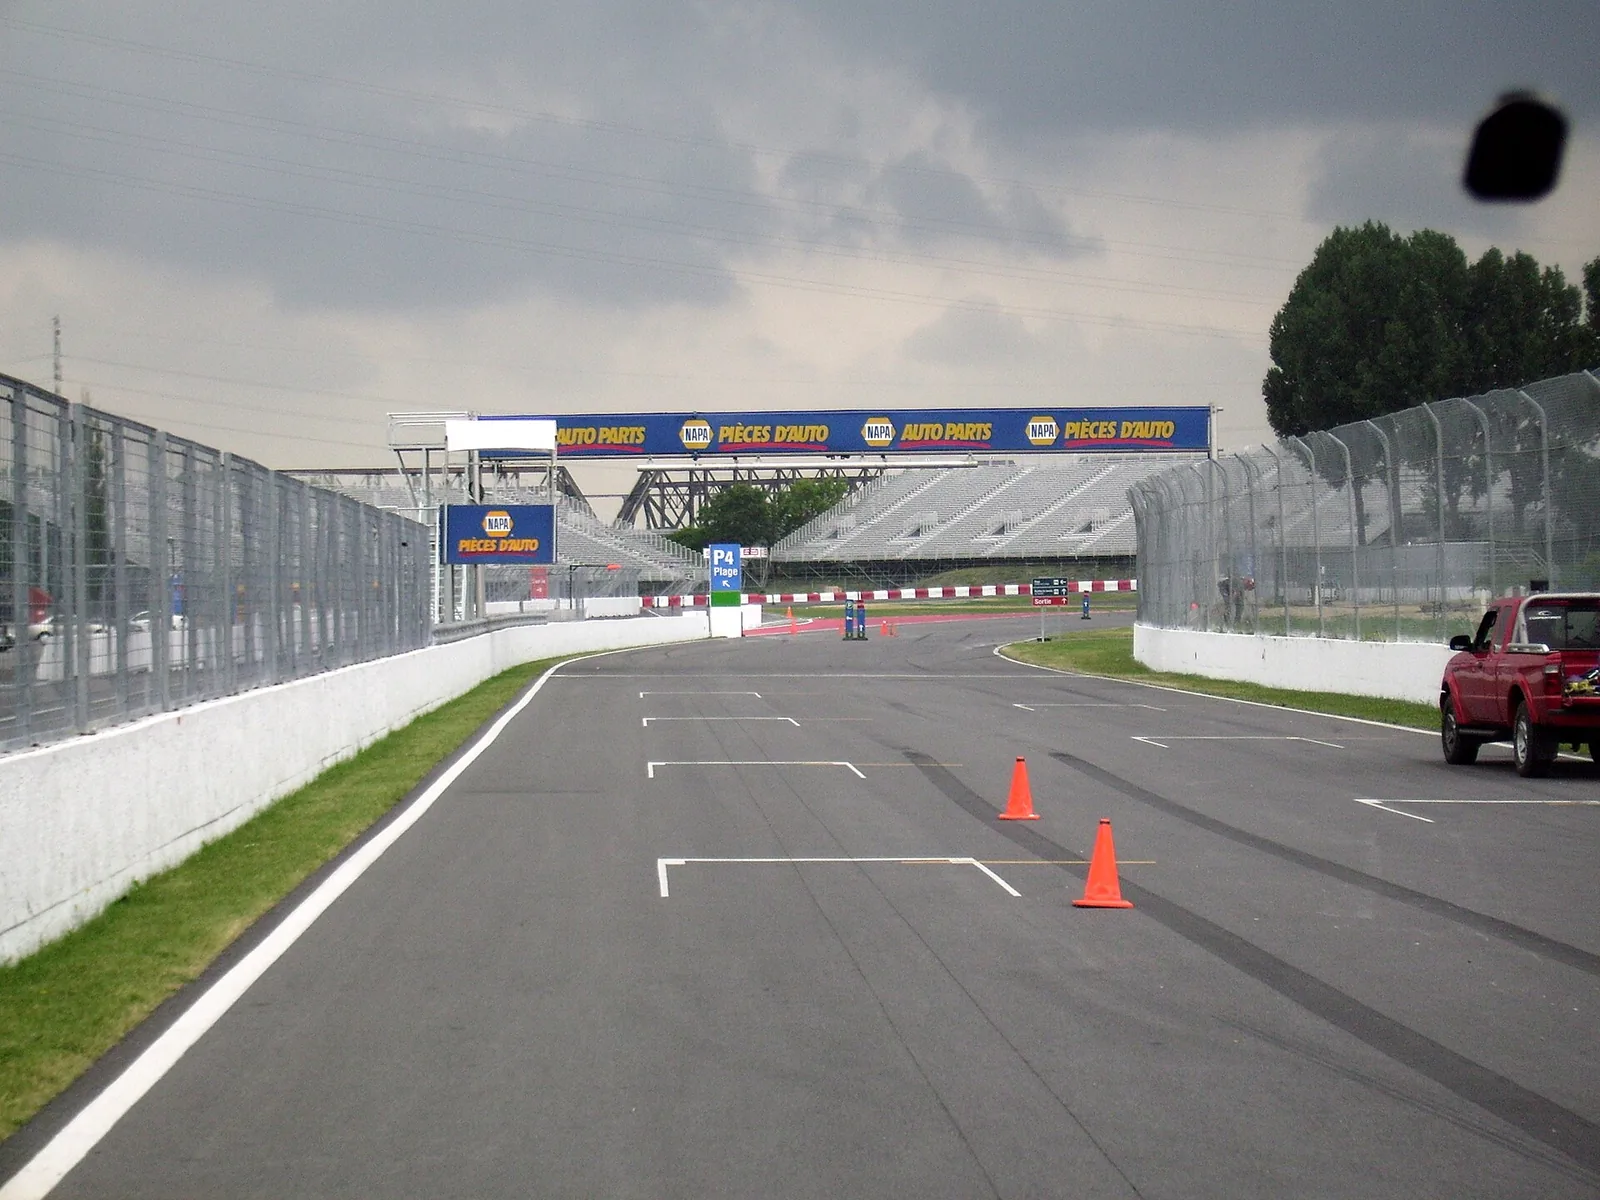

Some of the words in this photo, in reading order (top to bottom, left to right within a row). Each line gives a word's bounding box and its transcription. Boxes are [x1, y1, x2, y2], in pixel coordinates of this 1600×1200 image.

[556, 427, 597, 444] AUTO
[598, 426, 645, 444] PARTS
[685, 427, 709, 441] NAPA
[718, 422, 771, 443] PIÈCES
[774, 425, 829, 443] D'AUTO
[867, 425, 891, 439] NAPA
[900, 423, 944, 441] AUTO
[944, 423, 992, 441] PARTS
[1031, 424, 1055, 438] NAPA
[1064, 417, 1117, 439] PIÈCES
[1120, 421, 1175, 439] D'AUTO
[487, 517, 509, 530] NAPA
[458, 537, 497, 552] PIÈCES
[499, 538, 539, 552] D'AUTO
[713, 549, 734, 566] P4
[713, 567, 738, 578] Plage
